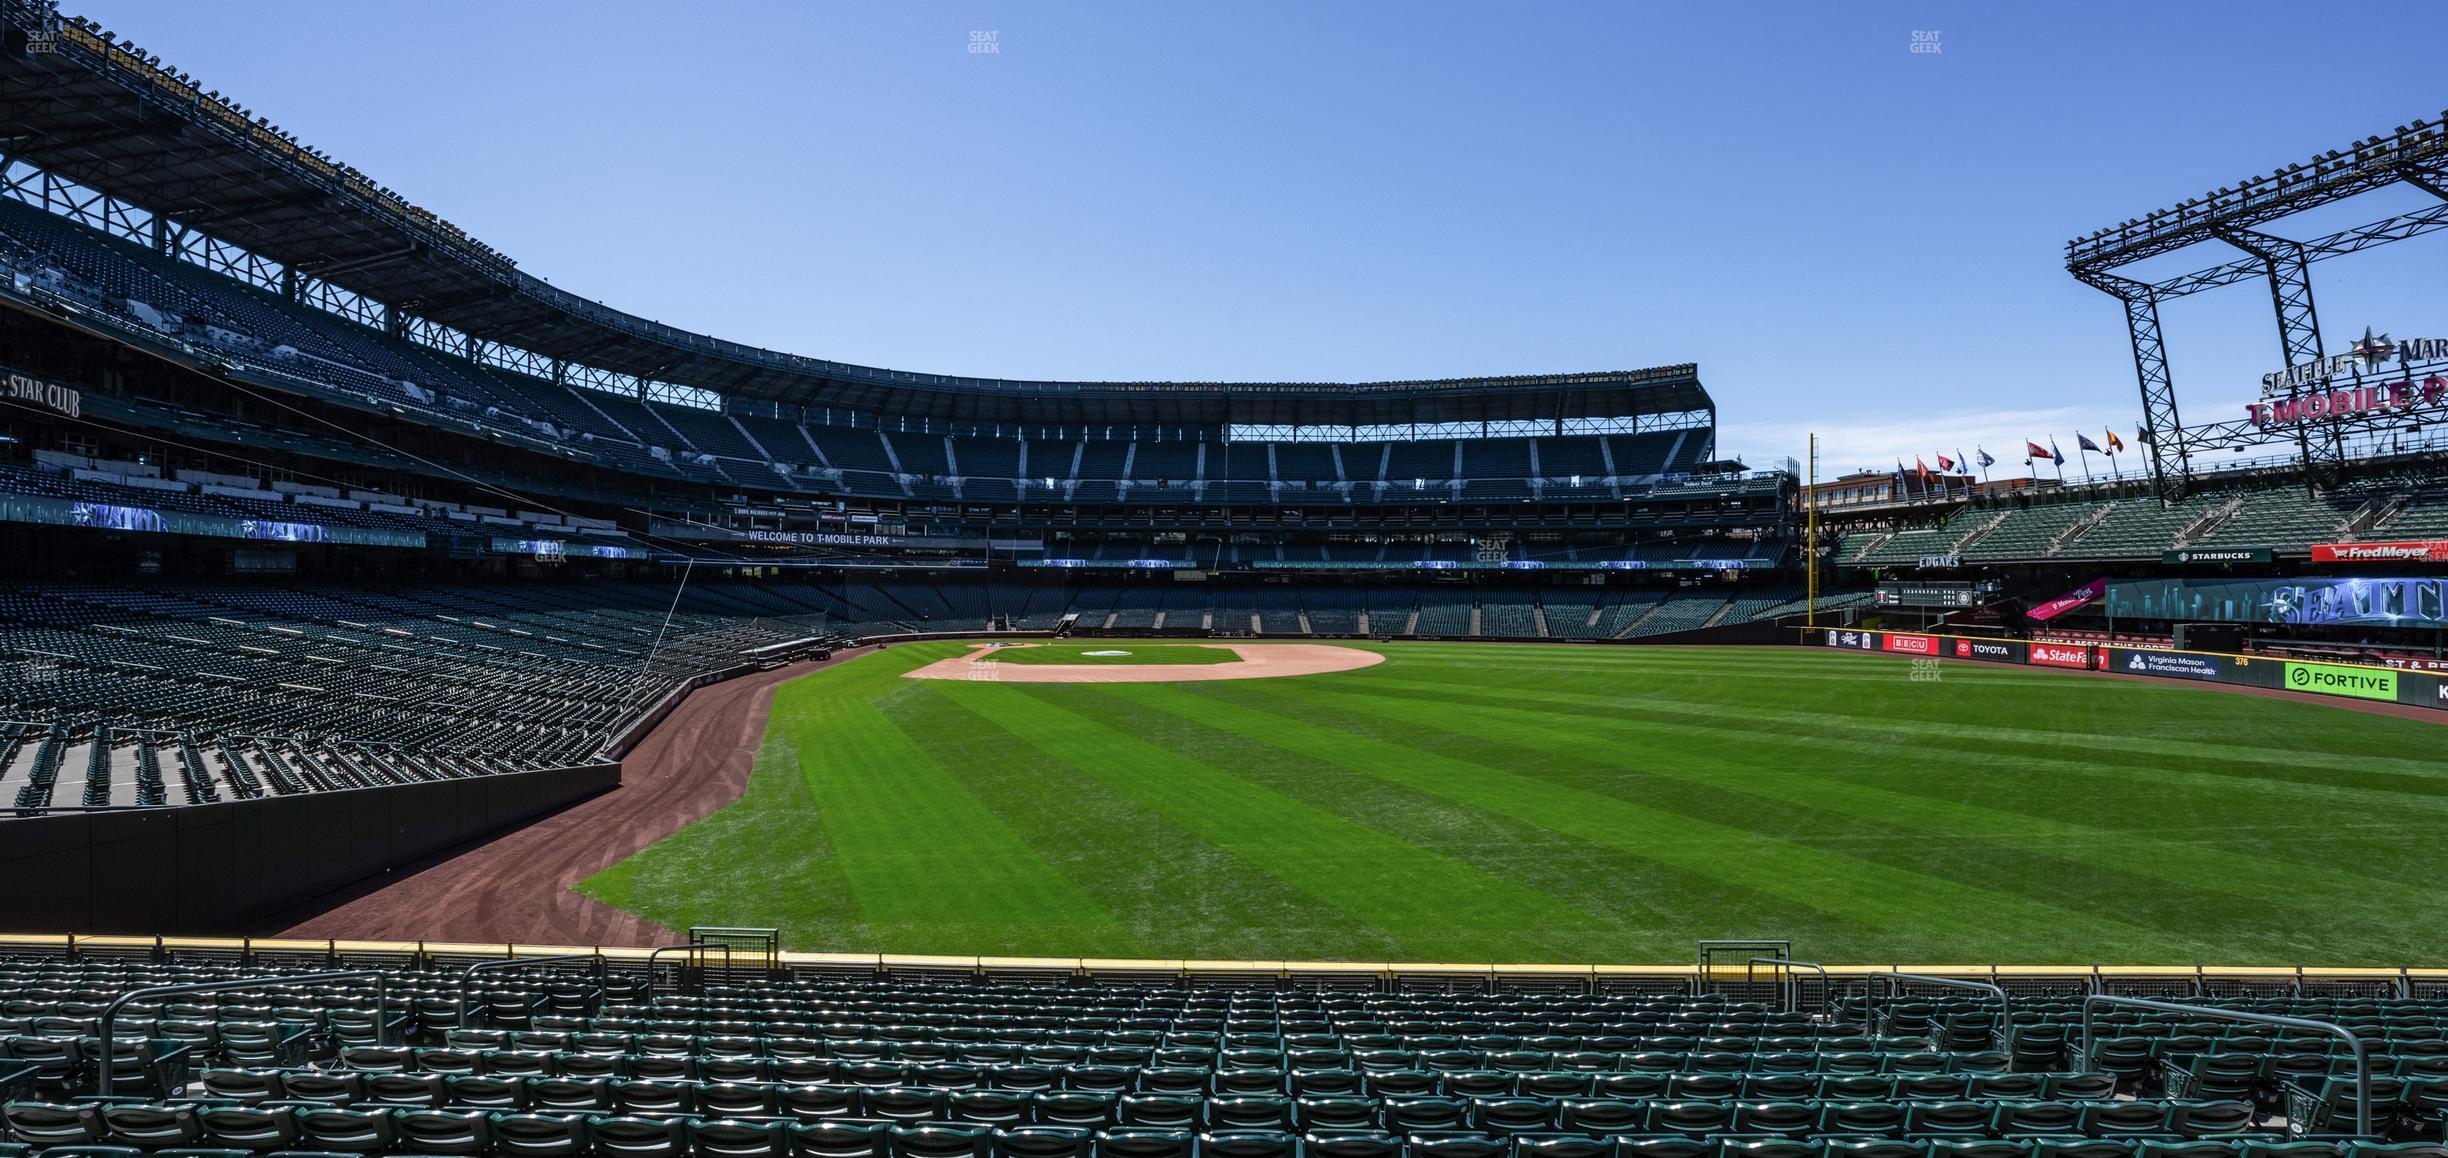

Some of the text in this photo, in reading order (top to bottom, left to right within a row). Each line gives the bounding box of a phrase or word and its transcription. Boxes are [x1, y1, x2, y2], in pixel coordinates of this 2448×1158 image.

[2262, 355, 2347, 393] SEATTLE
[10, 374, 80, 418] STAR CLUB
[2246, 380, 2416, 427] T-MOBILE
[749, 530, 889, 545] WELCOME TO T-MOBILE PARK
[2192, 552, 2251, 560] STARBUCKS
[1895, 638, 1925, 649] BECU
[1973, 644, 2008, 655] TOYOTA
[2148, 655, 2177, 665] Virginia
[2235, 656, 2248, 666] 376
[2148, 662, 2216, 675] Franciscan Health
[2314, 672, 2389, 691] FORTIVE
